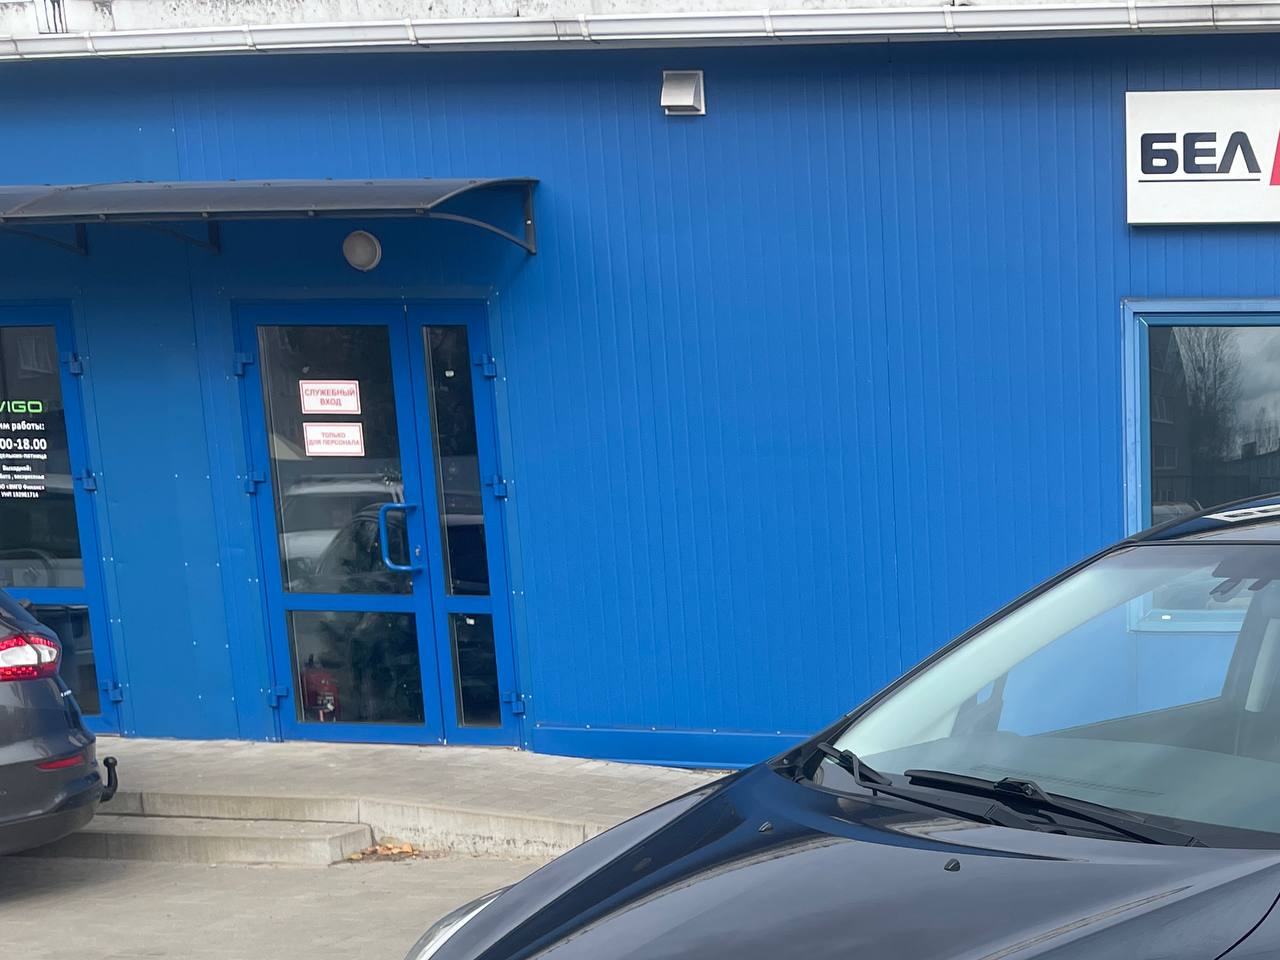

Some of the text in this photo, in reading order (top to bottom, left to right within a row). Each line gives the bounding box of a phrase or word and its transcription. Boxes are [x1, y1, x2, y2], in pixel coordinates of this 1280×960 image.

[1140, 130, 1262, 175] БЕЛ
[305, 387, 355, 397] СЛУЖЕБНЫЙ
[320, 398, 342, 406] ВХОД
[11, 420, 45, 431] работы:
[321, 431, 346, 439] ТОЛЬКО
[0, 438, 47, 450] 00-18.00
